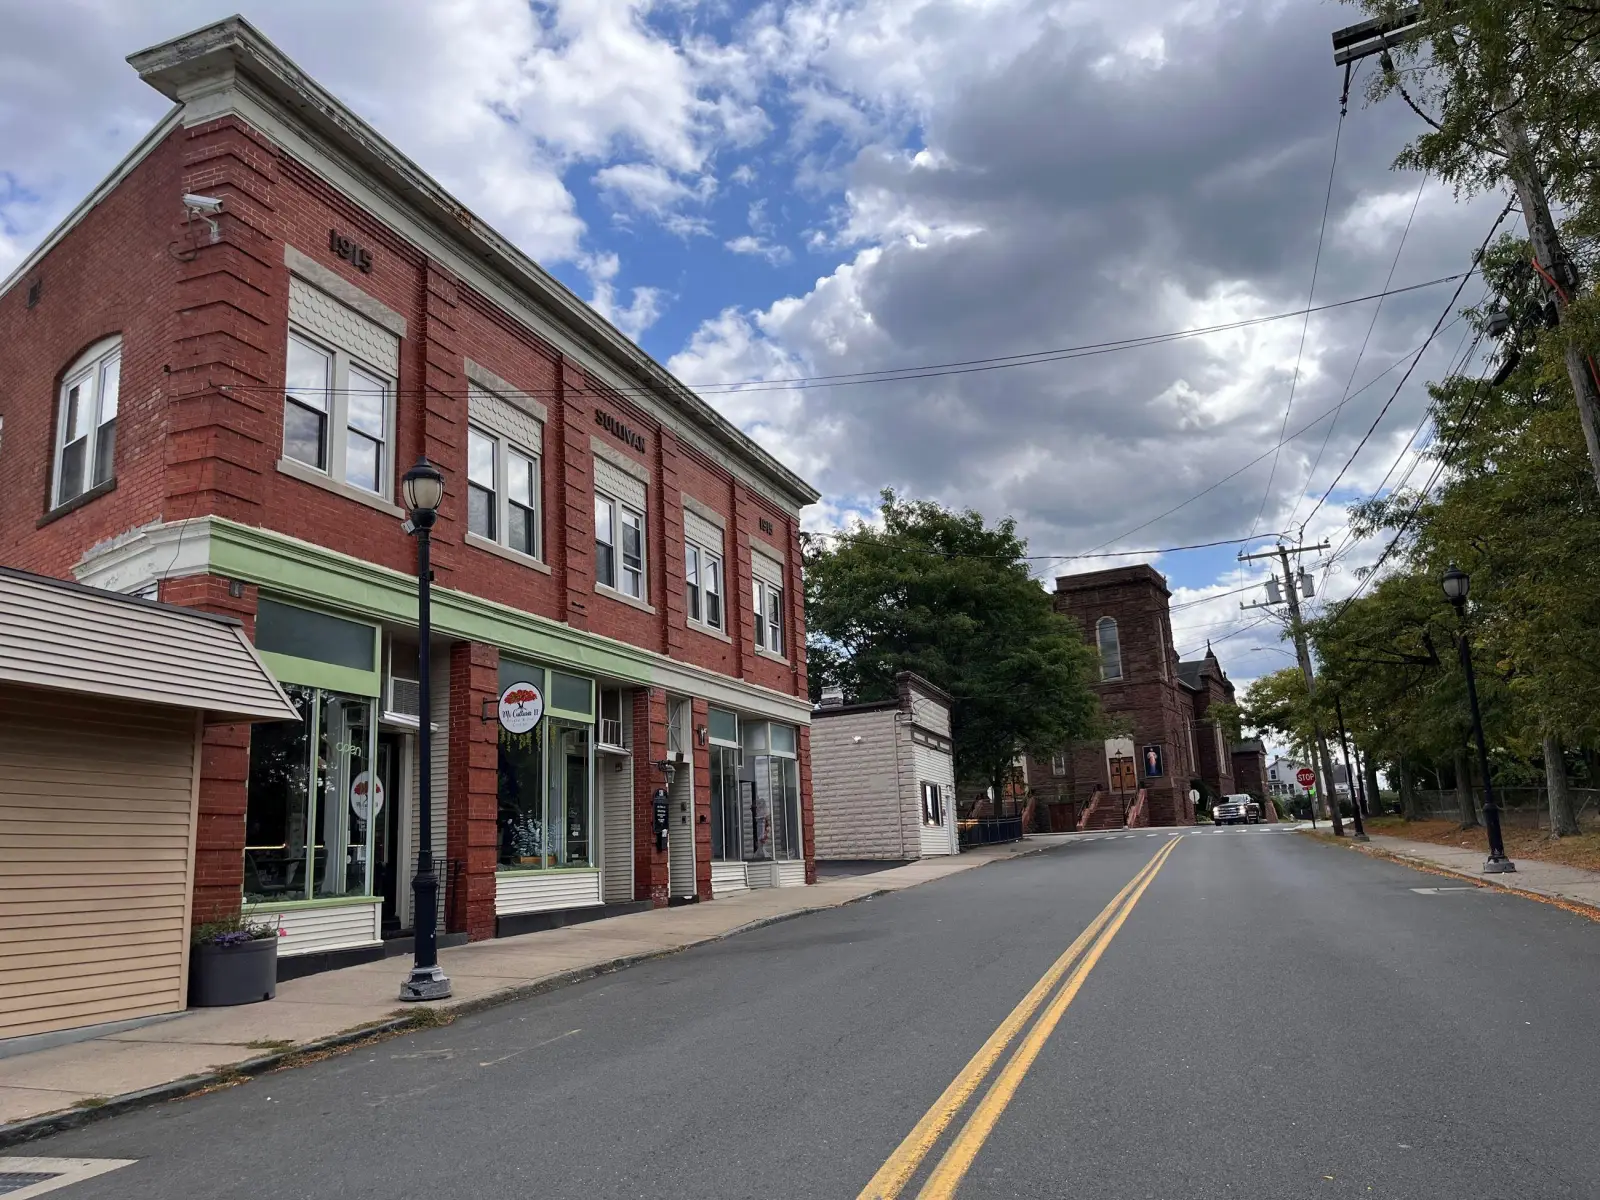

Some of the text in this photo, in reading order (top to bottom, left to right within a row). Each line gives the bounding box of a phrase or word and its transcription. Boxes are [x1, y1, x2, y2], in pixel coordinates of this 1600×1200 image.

[329, 228, 373, 274] 1915
[595, 409, 645, 454] SULLIVAN
[1298, 773, 1315, 781] STOP
